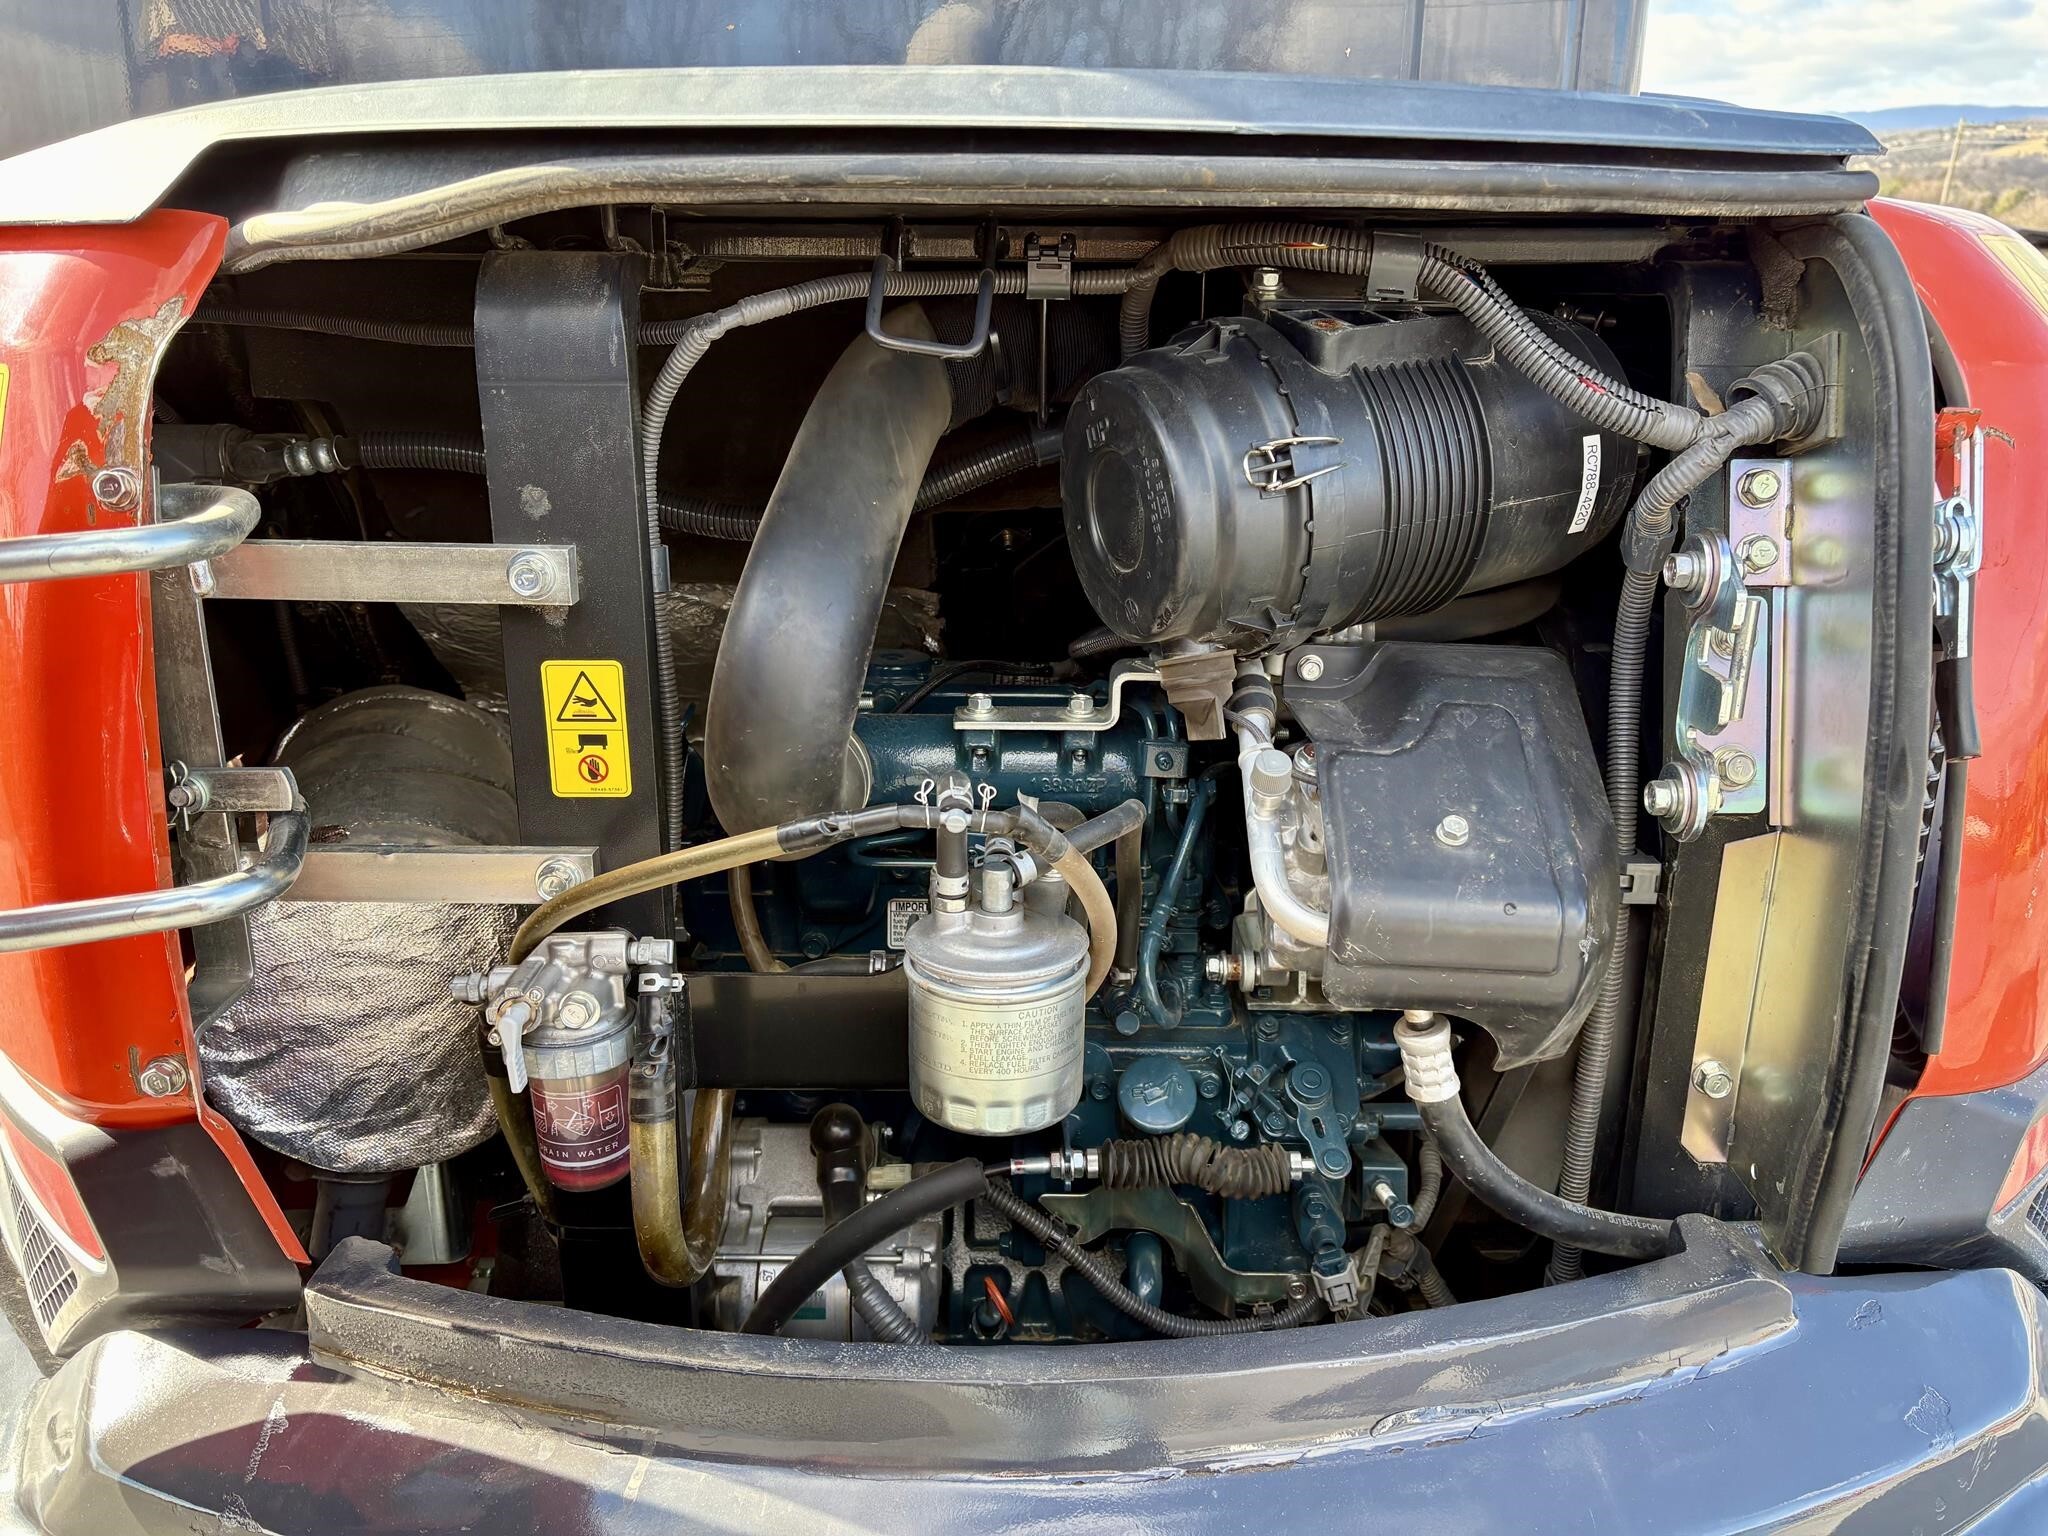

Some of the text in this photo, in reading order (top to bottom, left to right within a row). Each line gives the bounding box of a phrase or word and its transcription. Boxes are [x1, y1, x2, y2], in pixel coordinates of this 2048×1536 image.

[1574, 444, 1598, 526] RC788-4220
[1019, 1005, 1058, 1020] CAUTION
[988, 1027, 1022, 1036] SURFACE
[1037, 1020, 1062, 1031] GASKET
[1025, 1018, 1041, 1028] FILM
[1003, 1031, 1042, 1042] SCREWING
[1028, 1044, 1043, 1053] AND
[1029, 1054, 1050, 1066] FILTER
[577, 1141, 619, 1158] WATER
